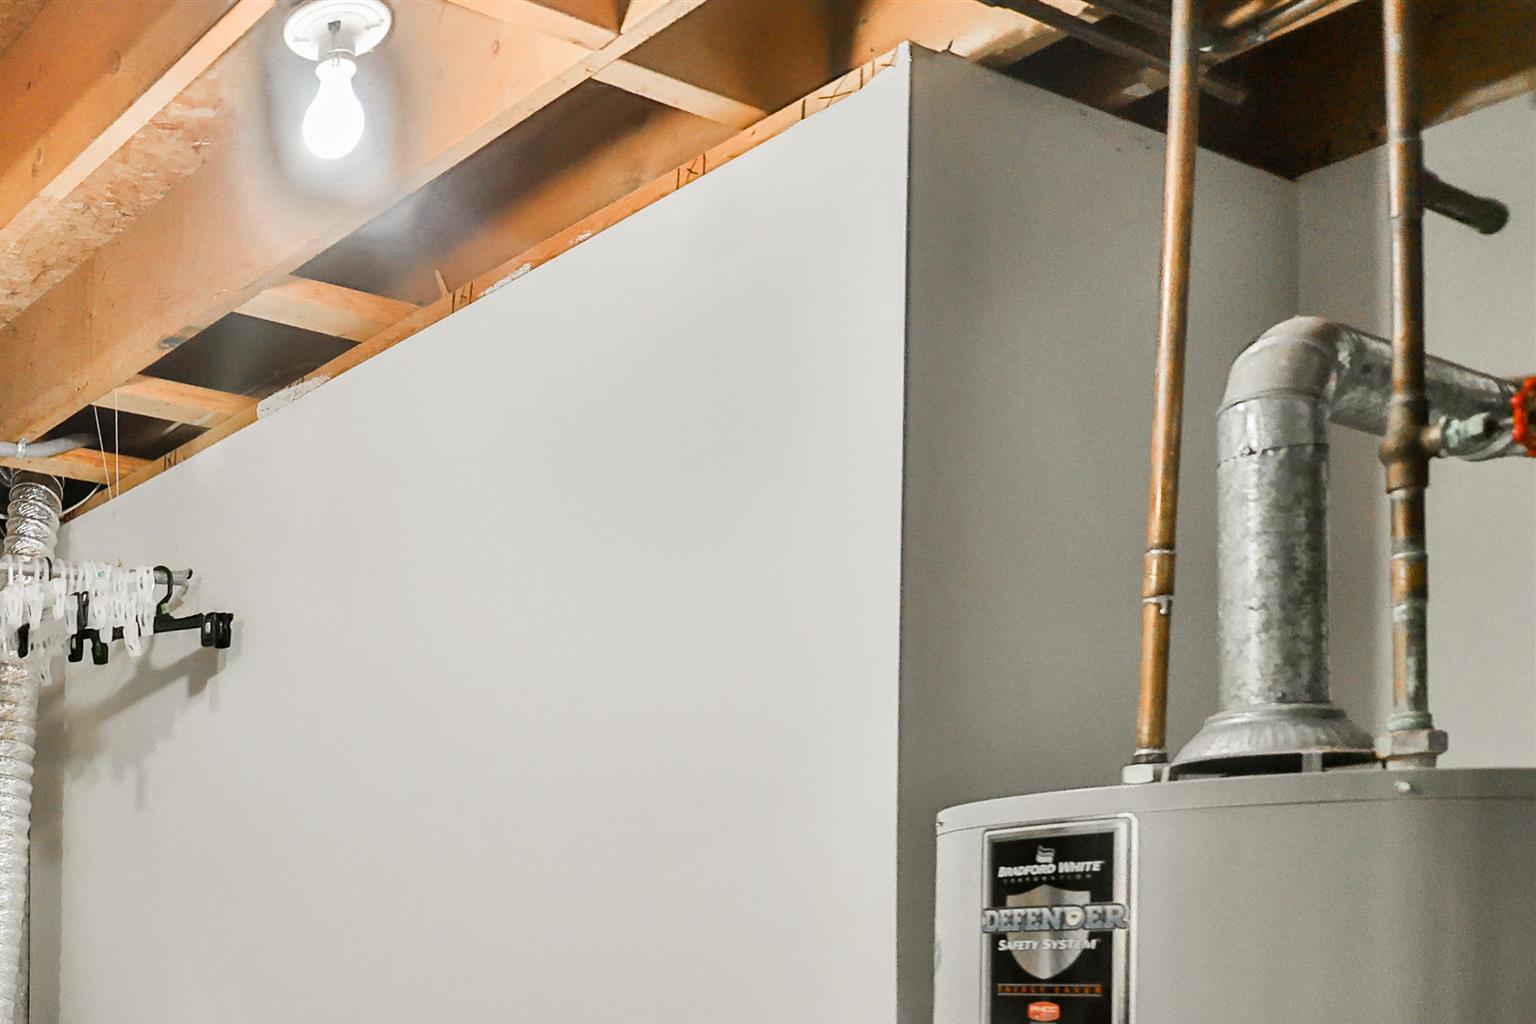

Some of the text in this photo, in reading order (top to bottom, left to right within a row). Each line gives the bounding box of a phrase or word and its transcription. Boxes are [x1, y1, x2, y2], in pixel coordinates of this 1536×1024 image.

[998, 861, 1103, 878] BRADFORD WHITE
[983, 903, 1126, 933] DEFENDER
[998, 939, 1039, 951] SAFETY
